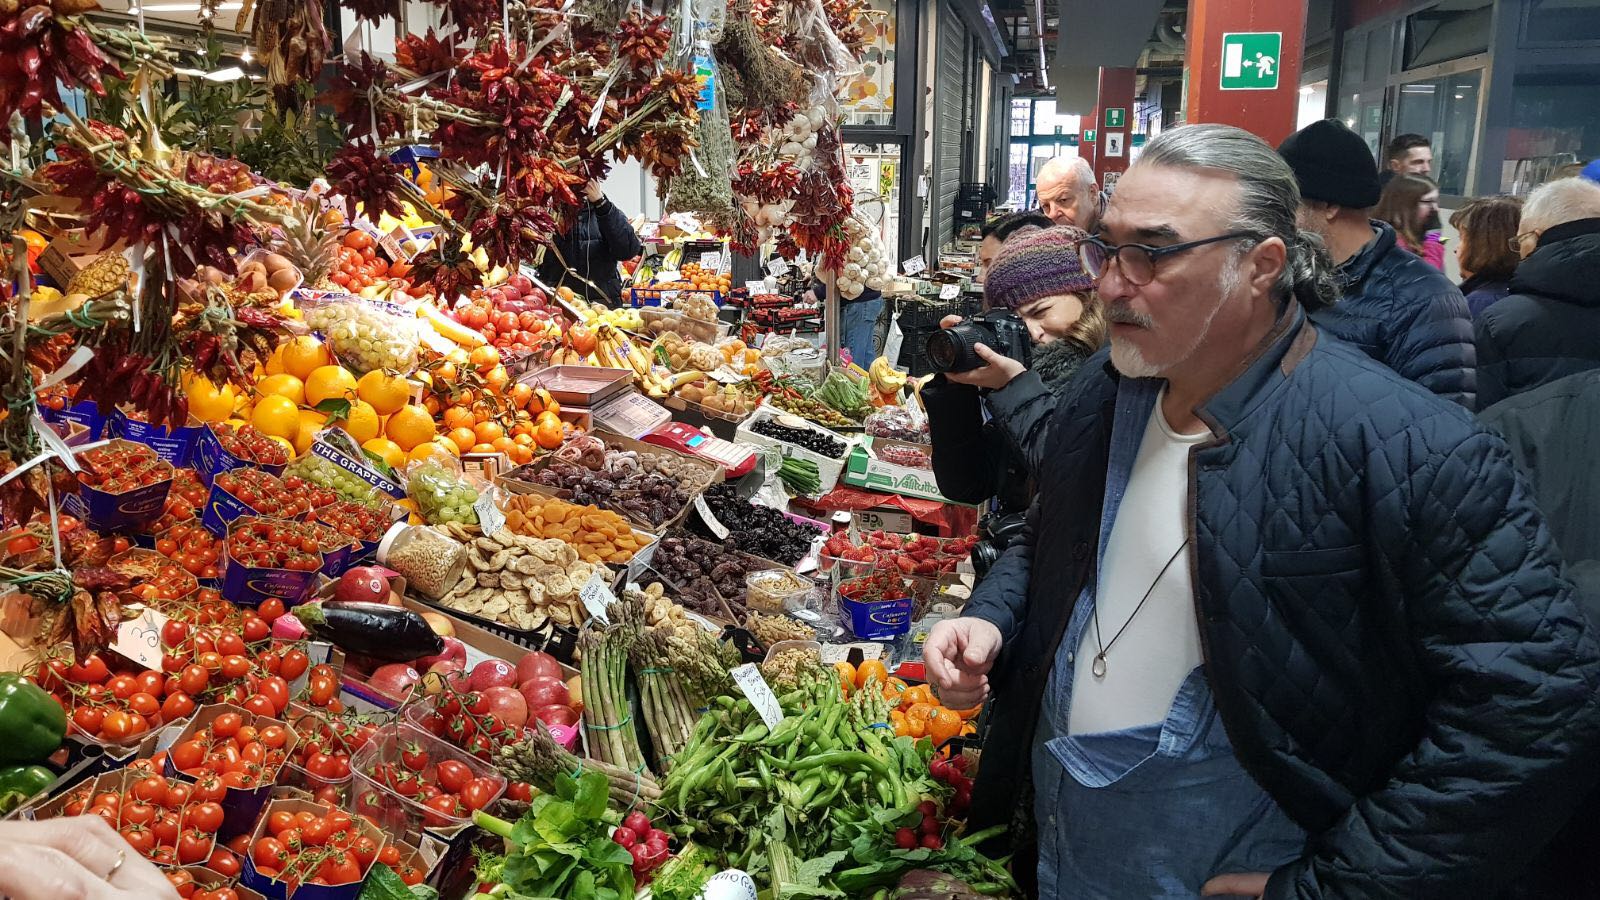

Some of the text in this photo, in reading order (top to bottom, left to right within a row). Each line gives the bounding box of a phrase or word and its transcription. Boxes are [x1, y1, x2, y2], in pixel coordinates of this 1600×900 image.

[315, 443, 395, 493] THE GRAPE CO
[892, 474, 938, 494] Valitutto
